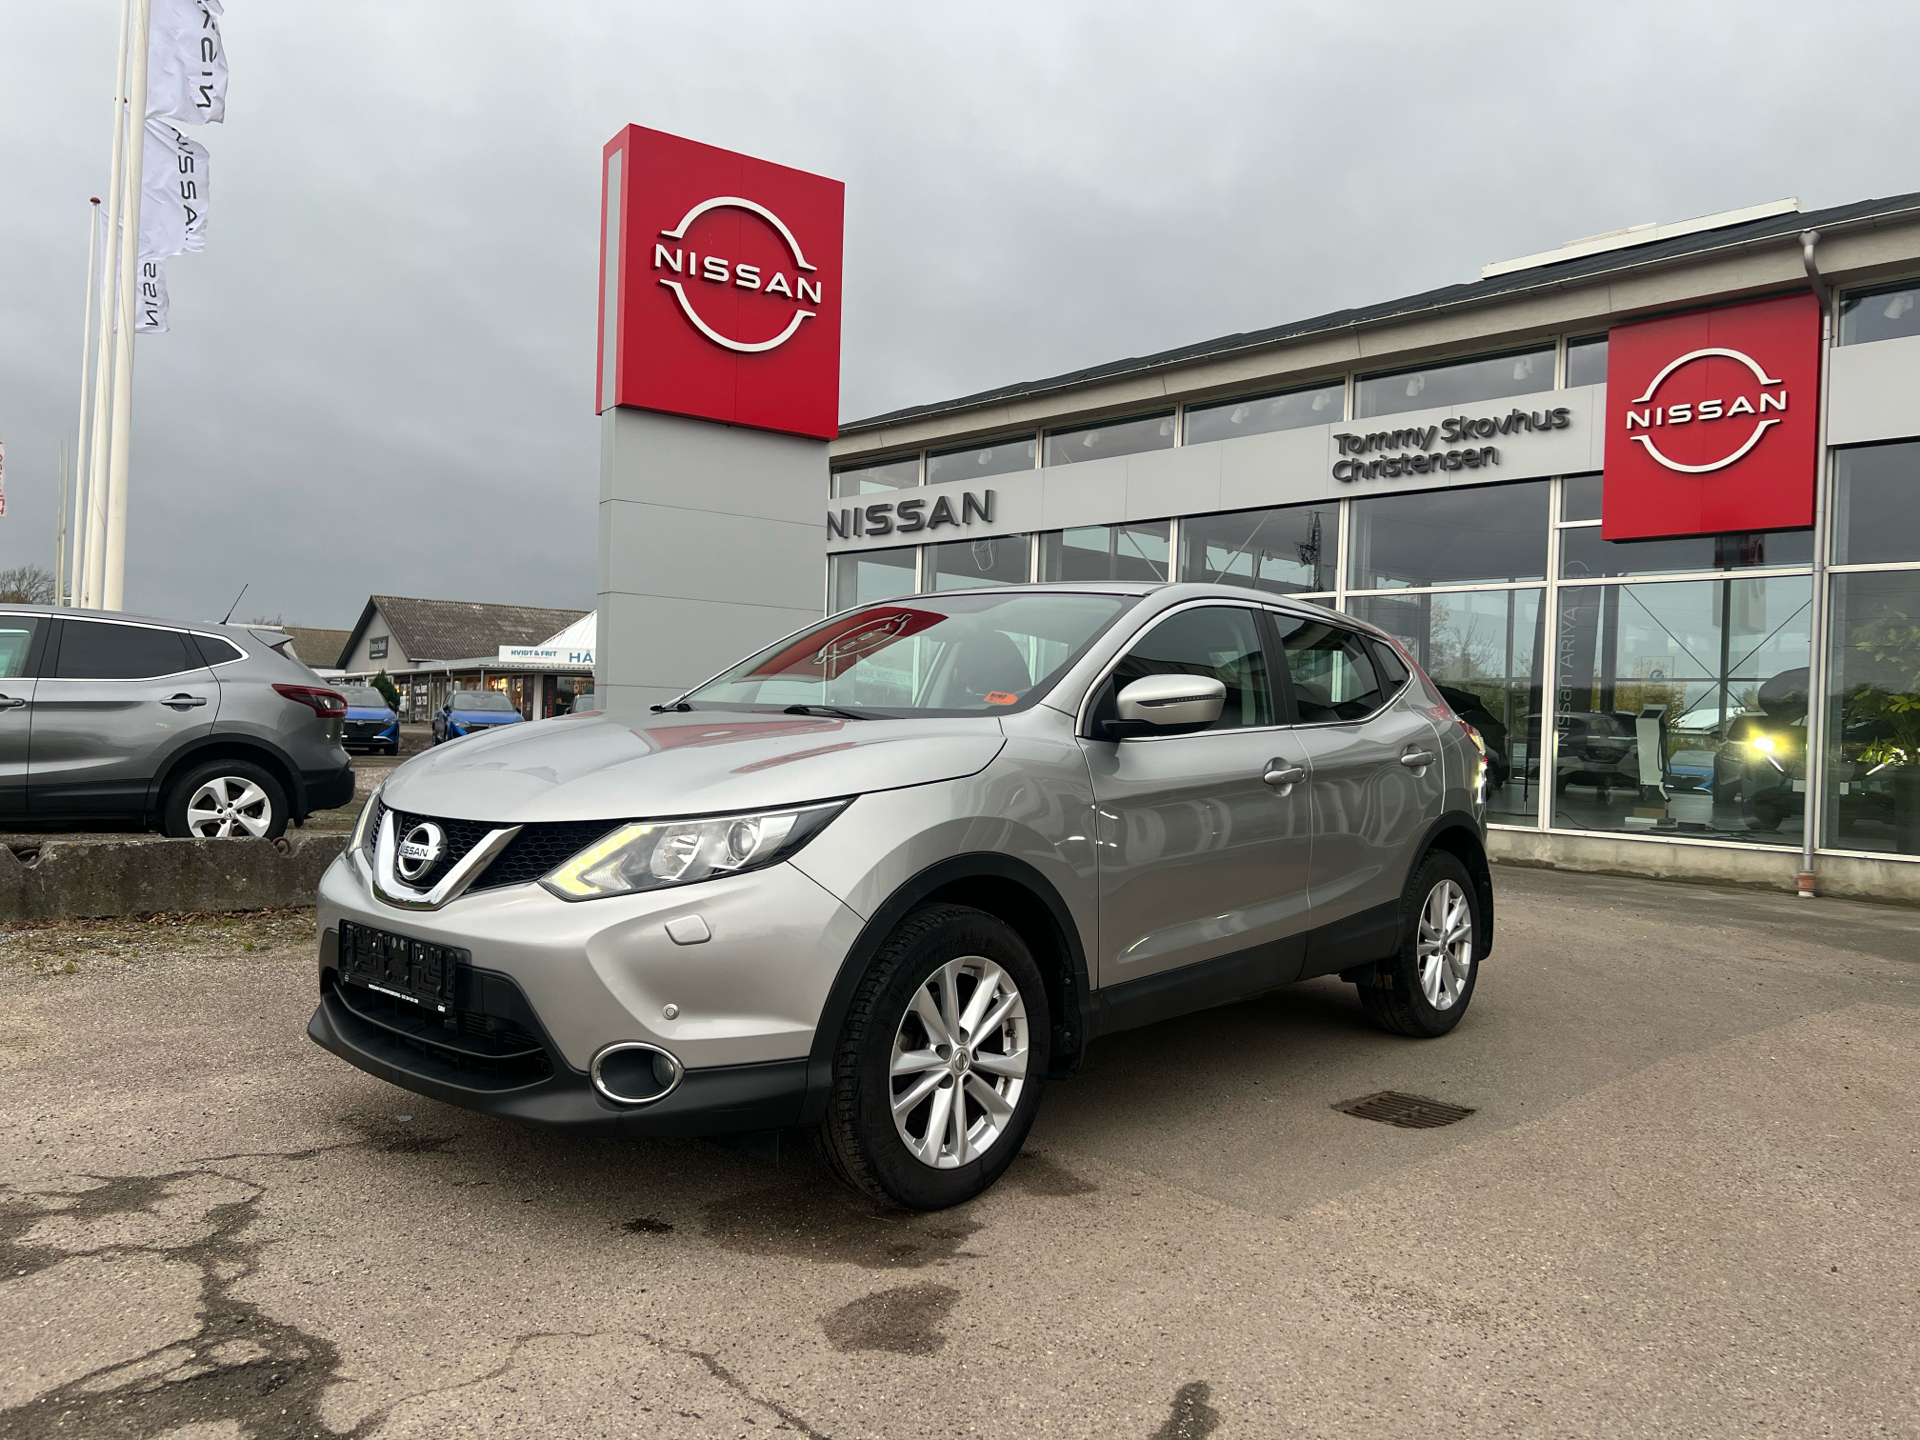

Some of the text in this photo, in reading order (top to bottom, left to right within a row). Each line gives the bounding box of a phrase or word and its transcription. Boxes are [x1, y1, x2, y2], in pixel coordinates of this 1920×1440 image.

[654, 243, 822, 304] NISSAN
[1333, 407, 1571, 456] Tommy Skovhus
[1626, 390, 1787, 430] NISSAN
[1332, 445, 1500, 483] Christensen
[827, 489, 997, 541] NISSAN
[1560, 606, 1579, 669] ARIYA
